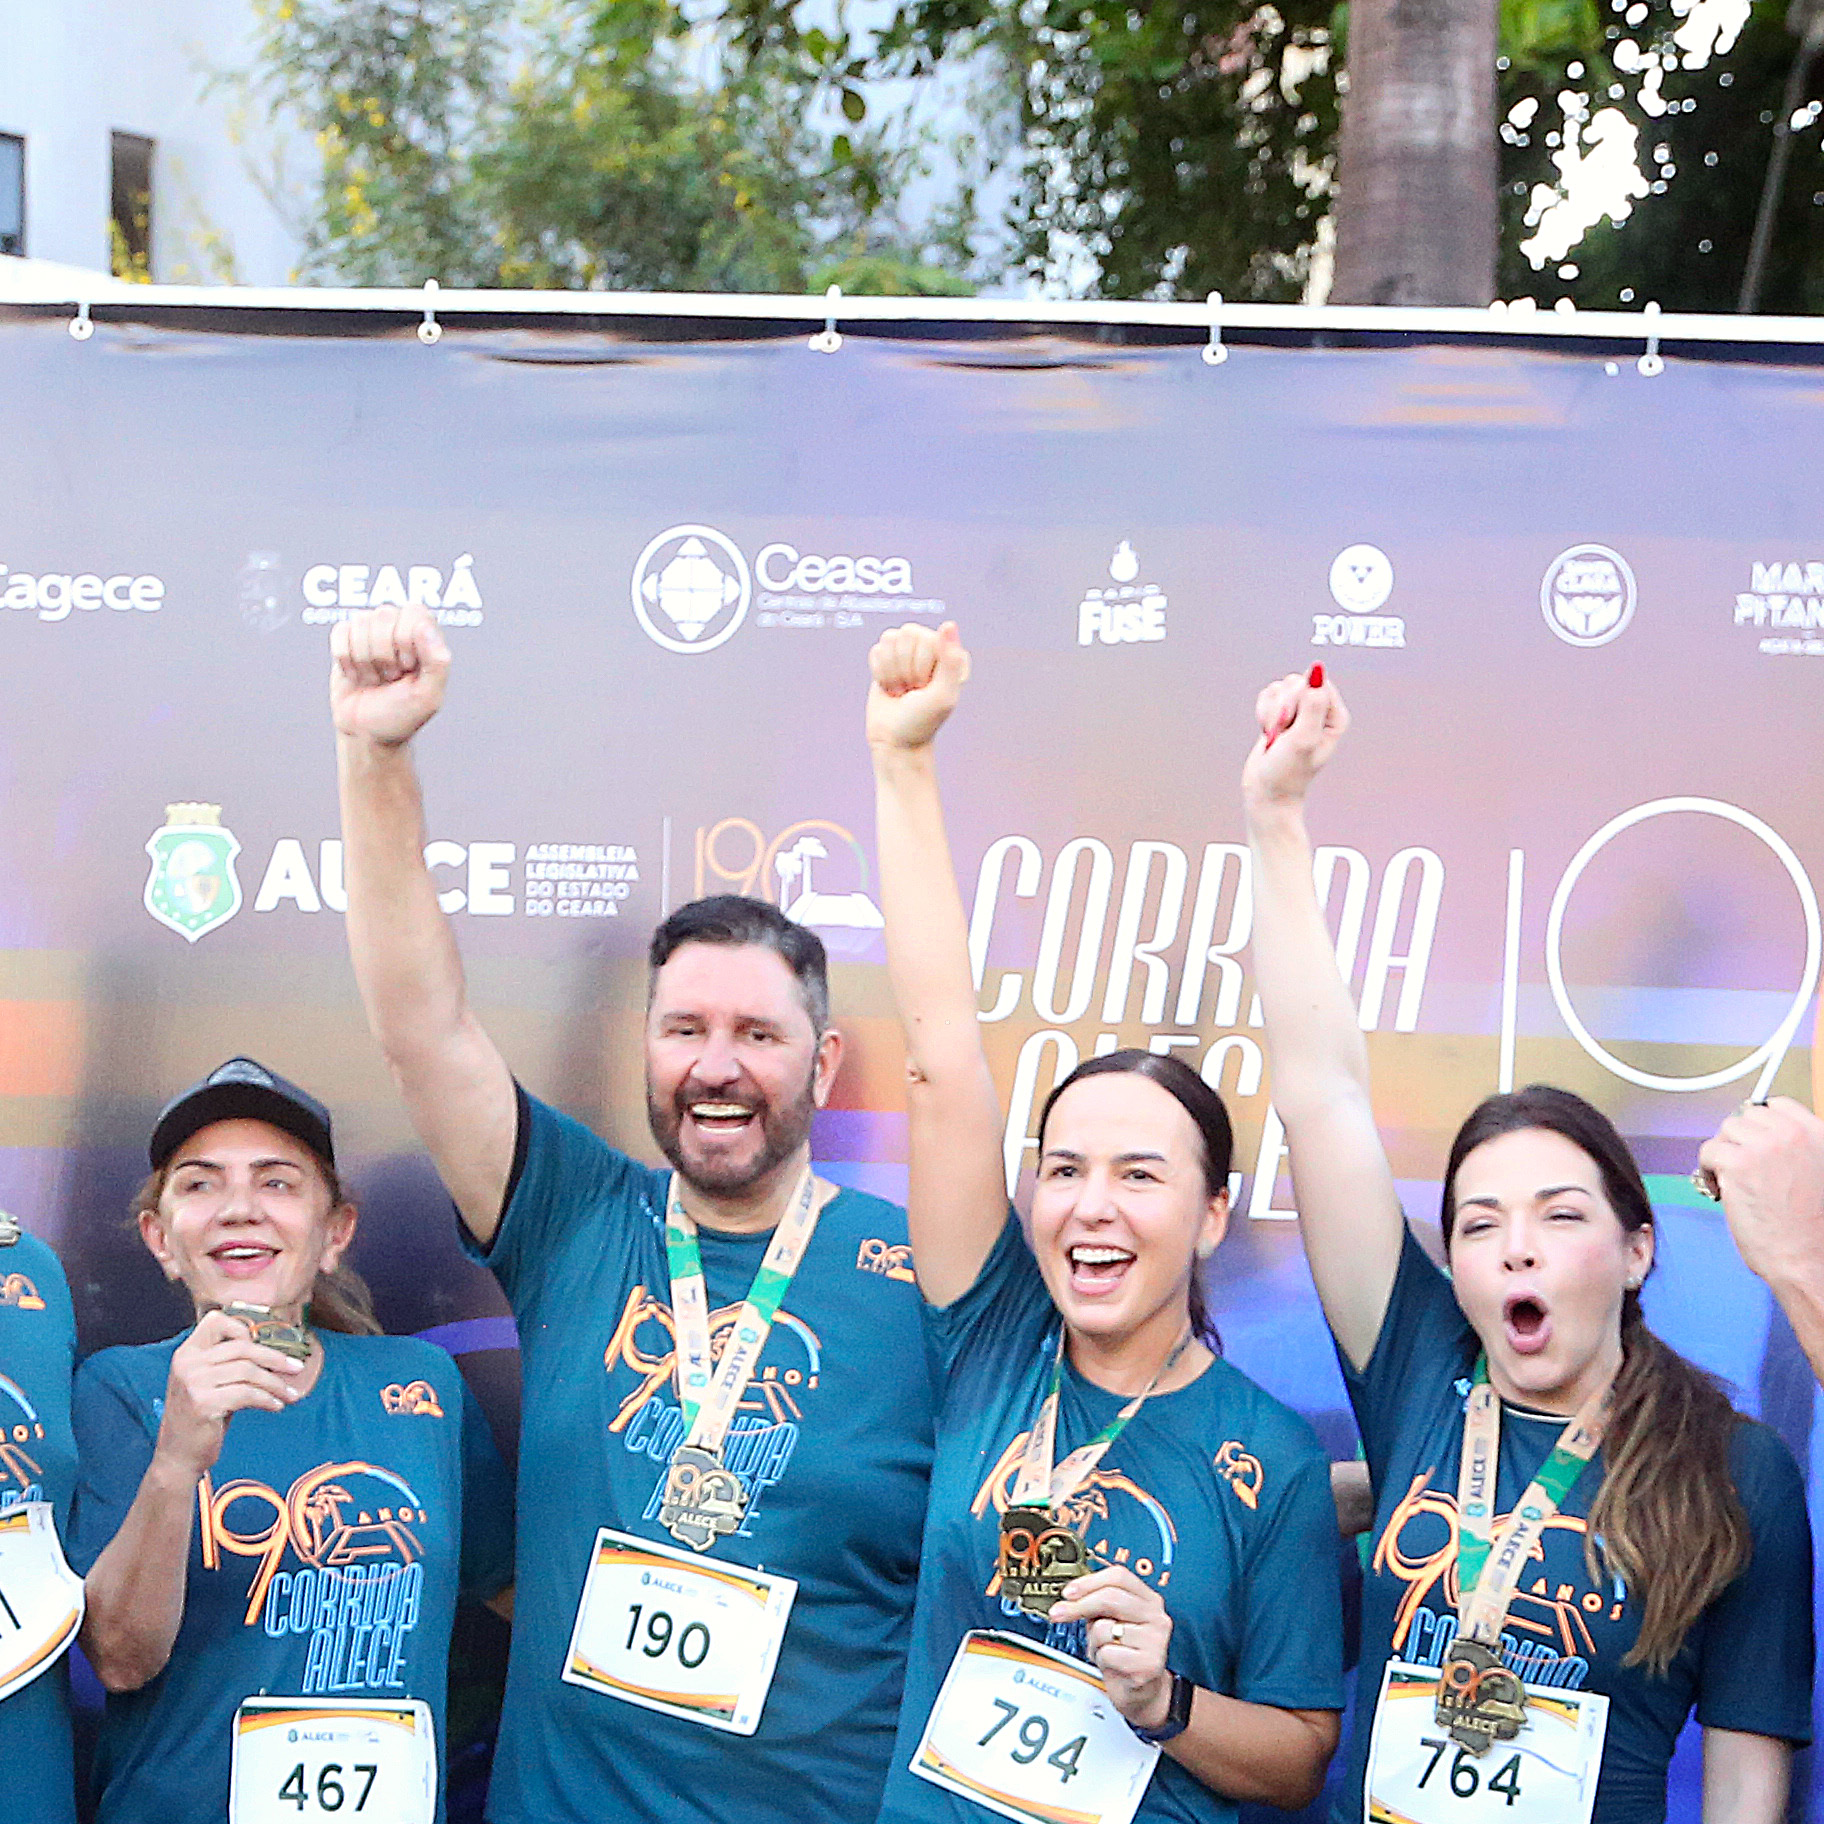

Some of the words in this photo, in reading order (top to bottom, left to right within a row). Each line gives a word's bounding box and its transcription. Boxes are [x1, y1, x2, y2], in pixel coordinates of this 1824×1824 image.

[301, 551, 483, 608] CEARÁ
[754, 542, 915, 595] Ceasa
[1077, 596, 1168, 647] FUSE
[524, 881, 554, 900] DO
[557, 881, 632, 902] ESTADO
[524, 899, 554, 918] DO
[968, 834, 1446, 1034] CORRDA
[678, 1510, 717, 1529] ALECE
[651, 1577, 684, 1594] ALECE
[1094, 1538, 1171, 1587] ANOS
[264, 1561, 425, 1639] CORRIDA
[1531, 1577, 1623, 1621] ANOS
[302, 1624, 413, 1694] ALECE
[625, 1603, 711, 1670] 190
[1027, 1676, 1061, 1698] ALECE
[301, 1732, 335, 1742] ALECE
[977, 1697, 1088, 1784] 794
[277, 1762, 378, 1812] 467
[1417, 1736, 1522, 1807] 764
